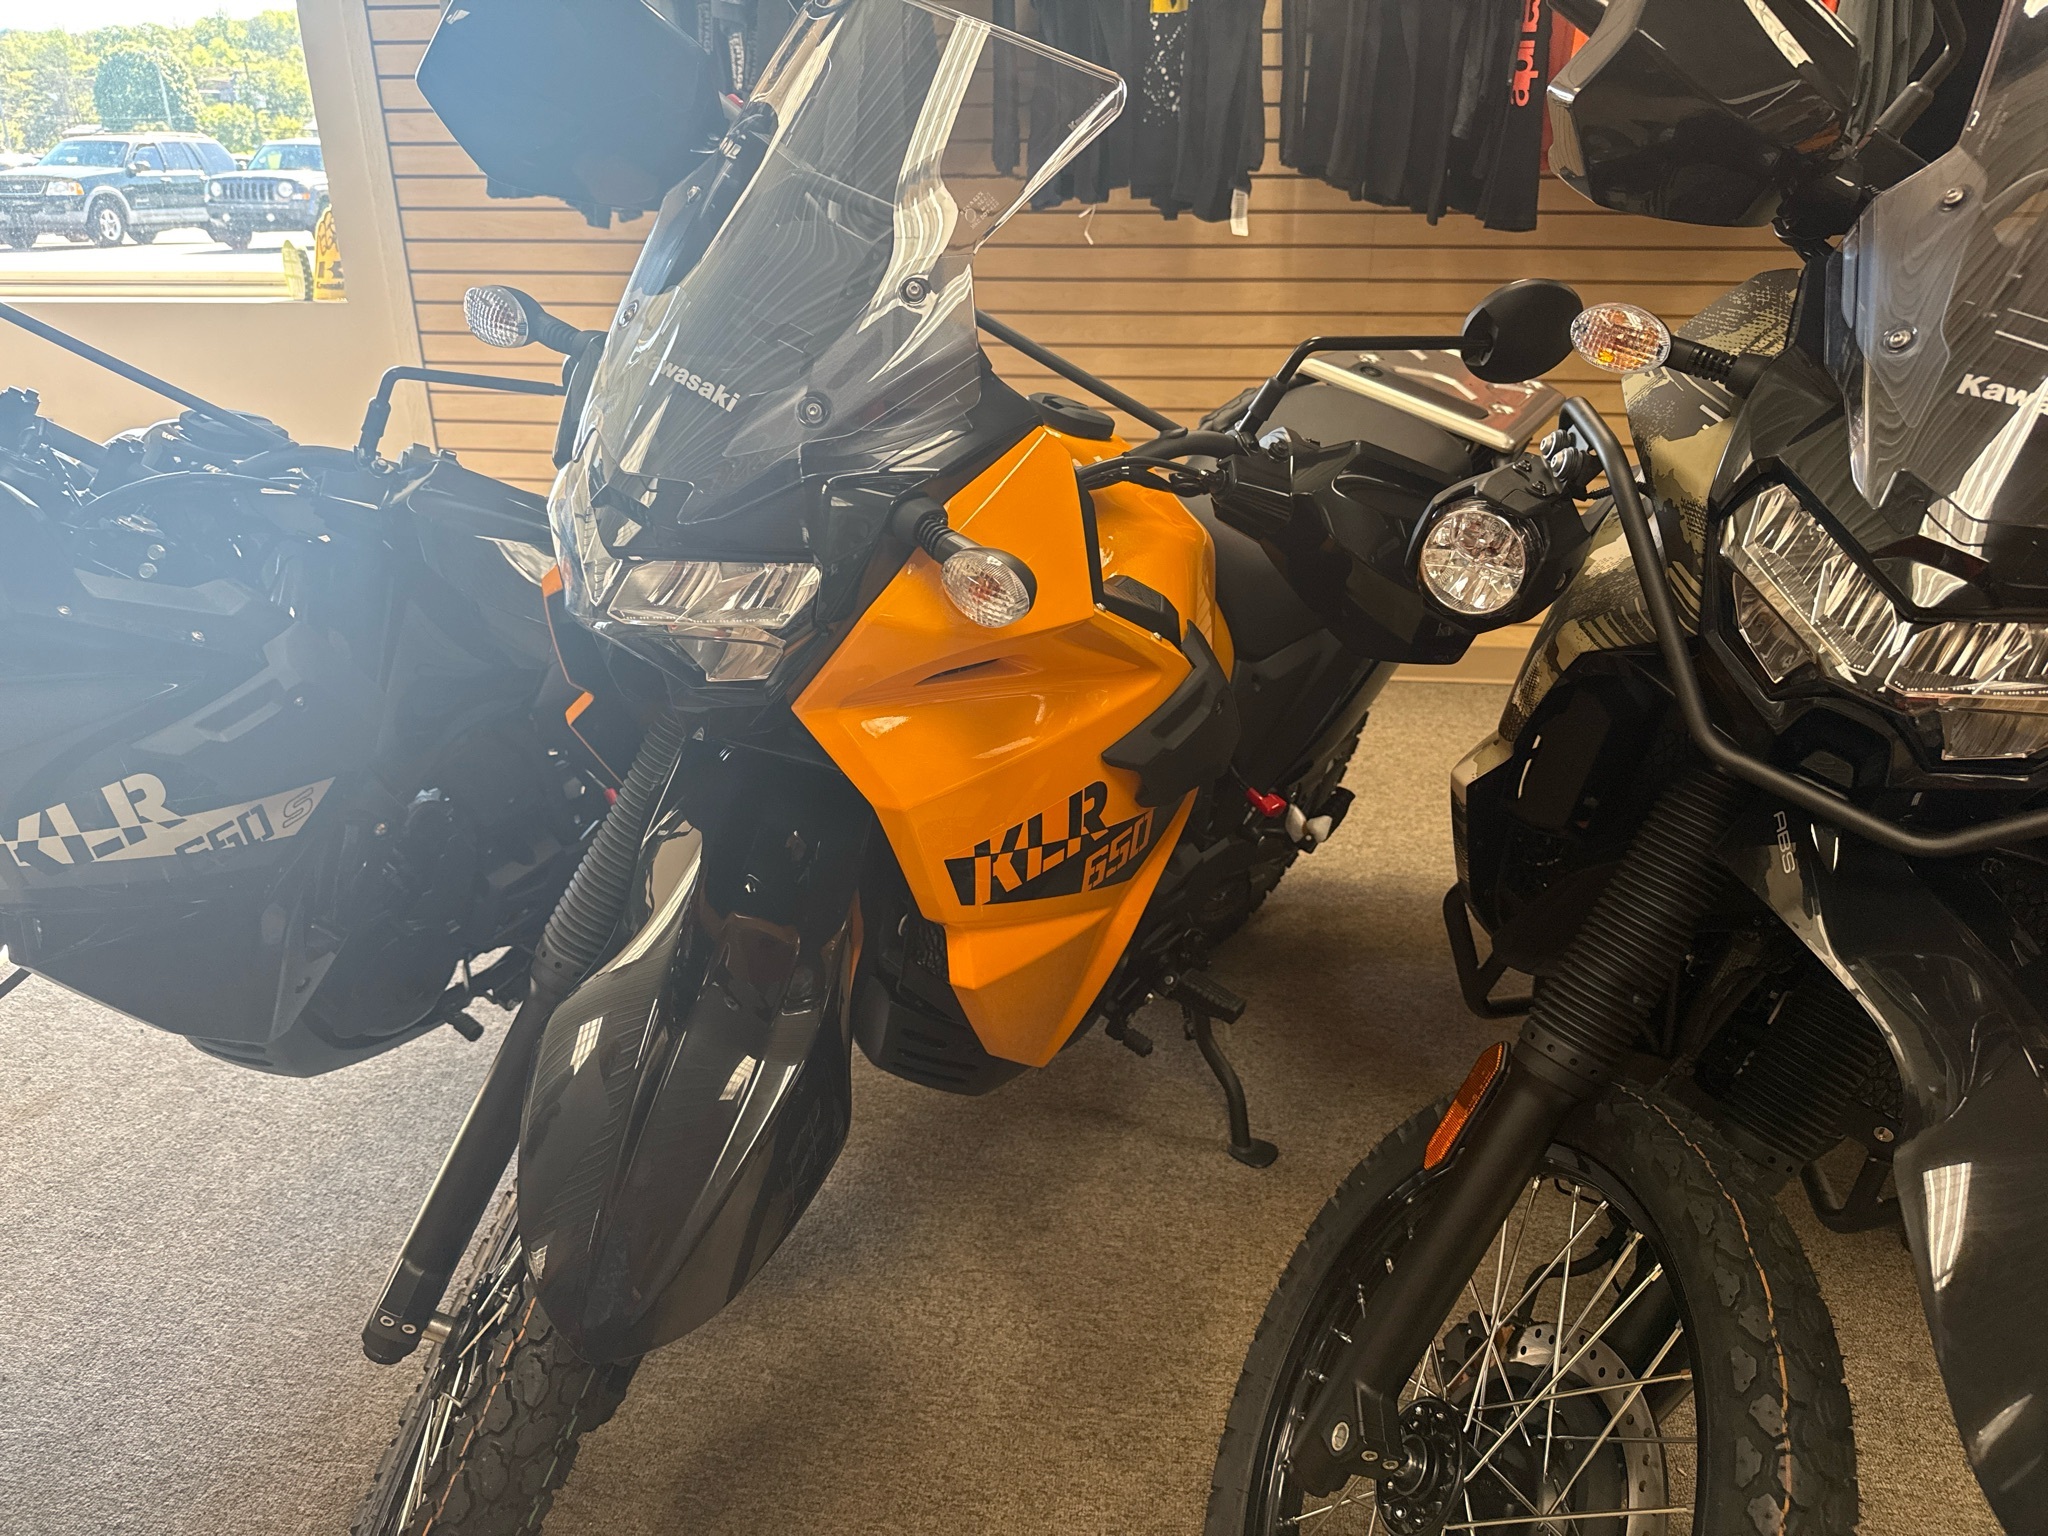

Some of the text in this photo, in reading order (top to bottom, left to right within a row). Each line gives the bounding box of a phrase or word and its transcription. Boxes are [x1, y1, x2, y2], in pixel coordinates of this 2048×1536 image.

[974, 780, 1109, 905] KLR
[1080, 811, 1153, 894] 650
[1773, 810, 1796, 874] ABS
